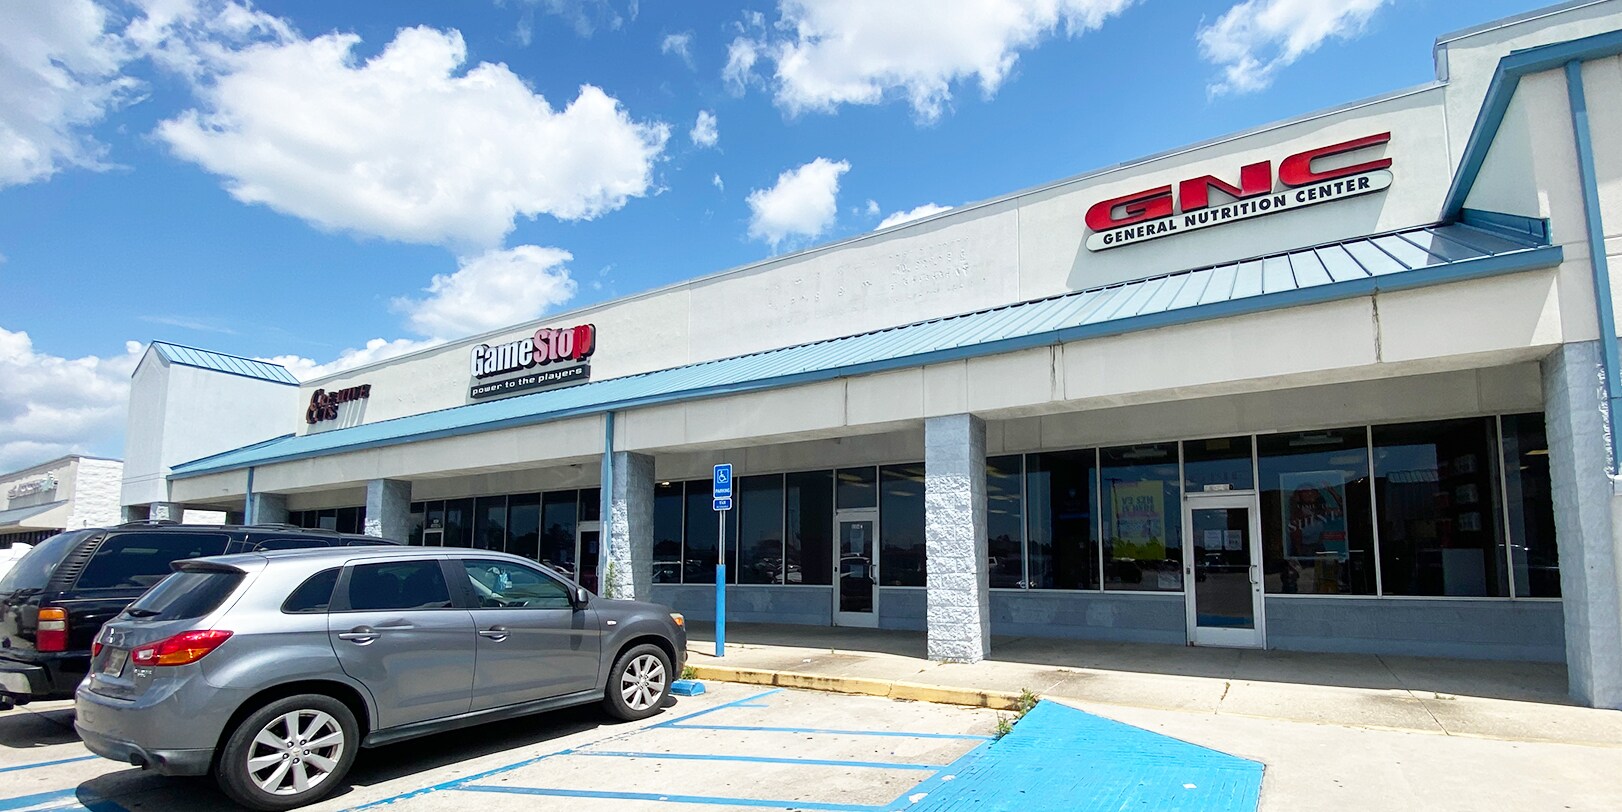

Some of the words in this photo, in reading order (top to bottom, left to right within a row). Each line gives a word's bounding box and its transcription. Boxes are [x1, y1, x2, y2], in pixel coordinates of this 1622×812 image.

[1085, 131, 1393, 232] GNC
[1103, 219, 1177, 245] GENERAL
[1184, 195, 1287, 227] NUTRITION
[1295, 176, 1371, 203] CENTER
[471, 324, 596, 379] GameStop
[472, 384, 502, 396] power
[518, 376, 535, 386] the
[538, 367, 583, 383] players
